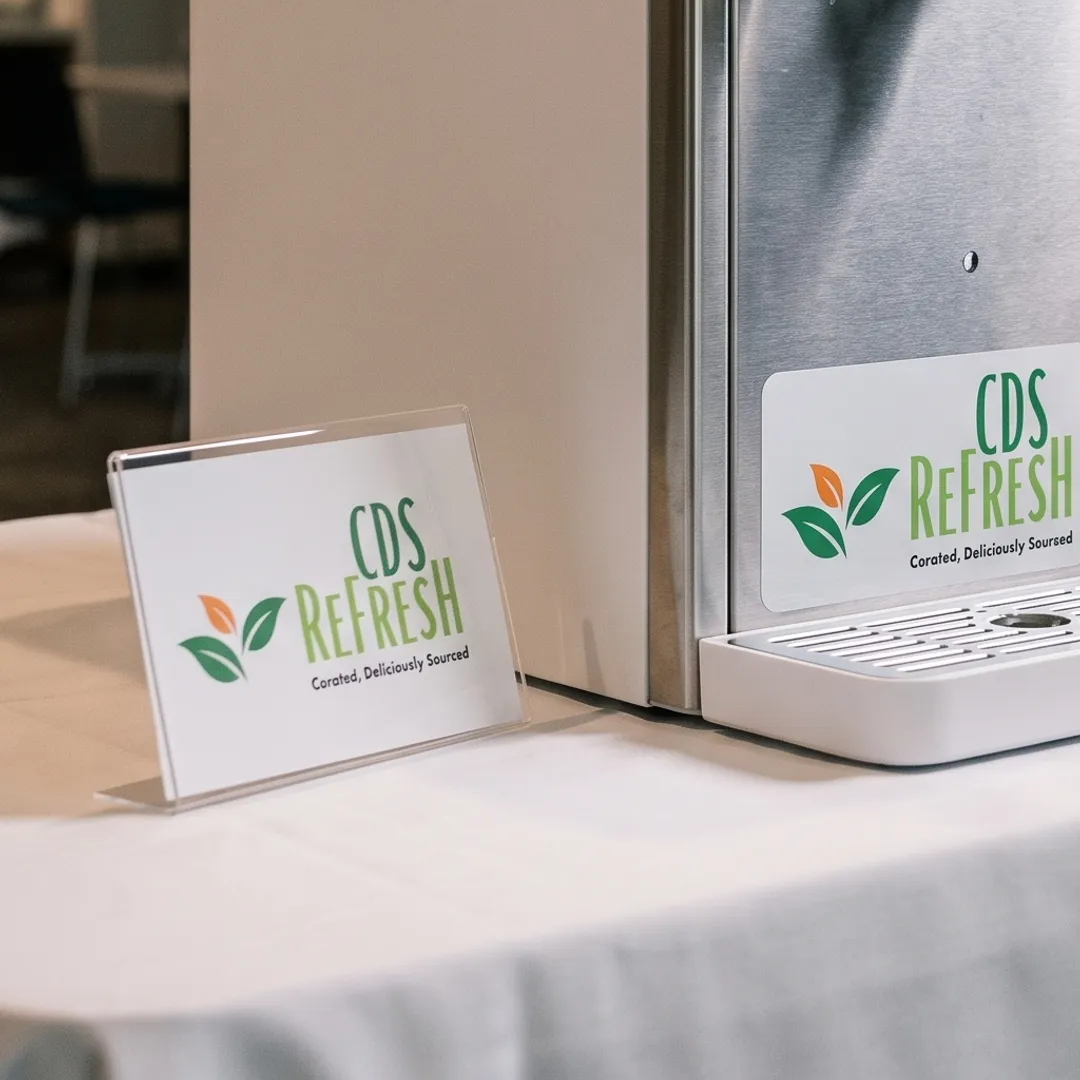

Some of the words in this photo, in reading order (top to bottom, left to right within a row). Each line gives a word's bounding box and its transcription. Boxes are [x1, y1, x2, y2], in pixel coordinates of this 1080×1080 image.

[976, 368, 1048, 455] CDS
[349, 496, 426, 580] CDS
[910, 548, 960, 569] Corated,
[964, 538, 1025, 560] Deliciously
[311, 669, 362, 691] Corated,
[364, 656, 424, 680] Deliciously
[427, 645, 470, 667] Sourced
